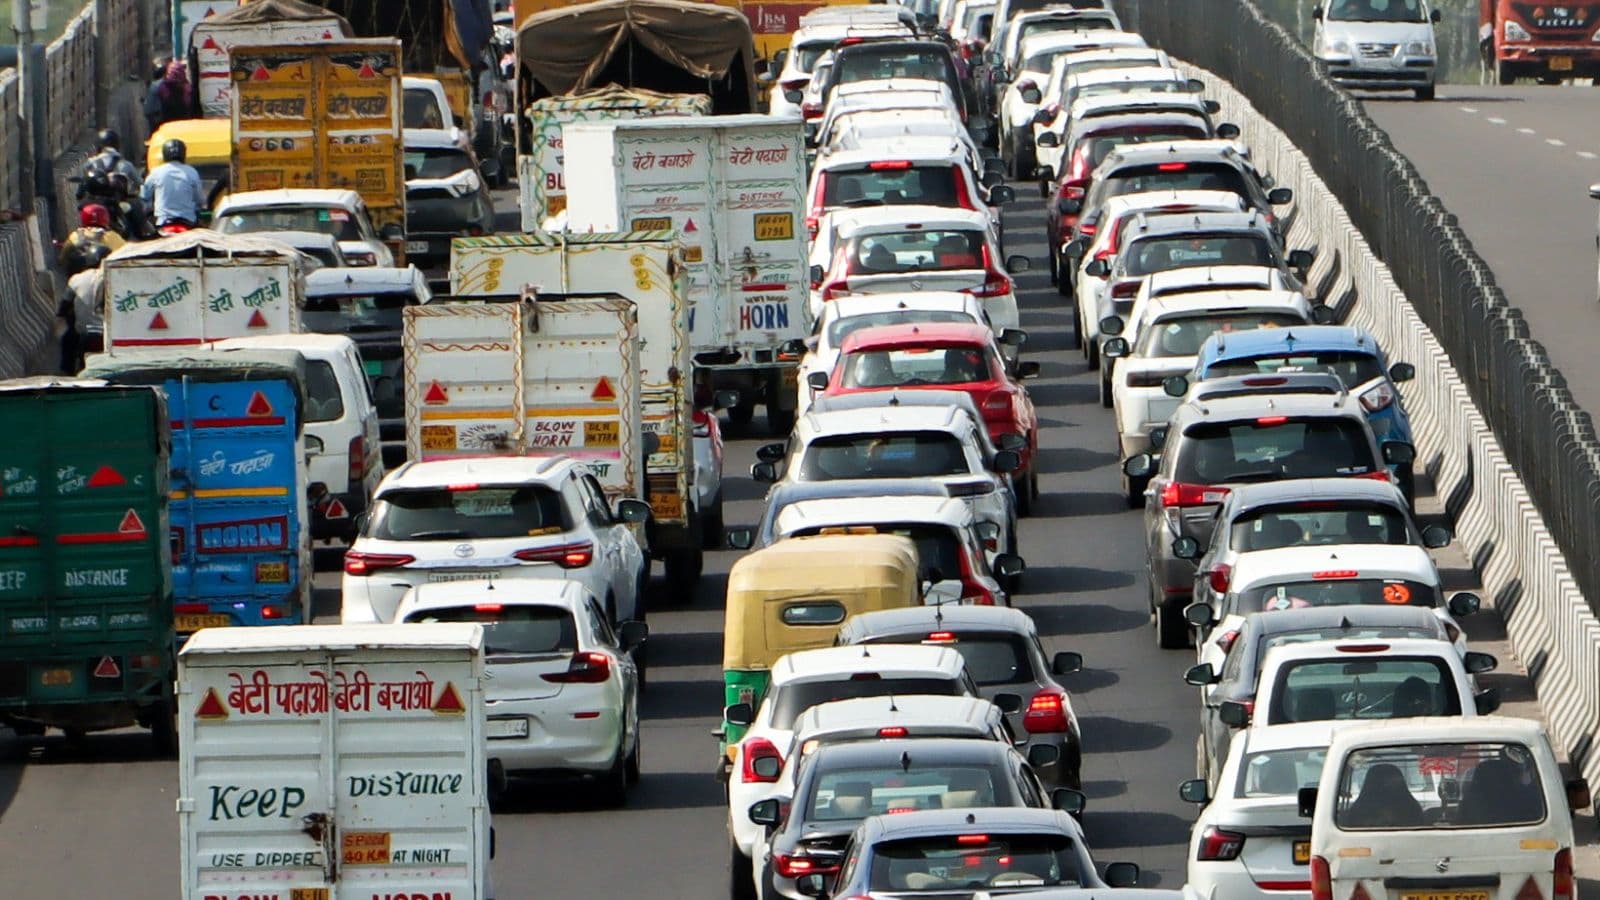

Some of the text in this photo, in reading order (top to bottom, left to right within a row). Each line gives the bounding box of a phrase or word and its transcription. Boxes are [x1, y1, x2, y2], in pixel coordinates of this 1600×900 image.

[739, 303, 789, 331] HORN
[535, 421, 576, 431] BLOW
[531, 434, 572, 448] HORN
[201, 522, 282, 549] HORN
[0, 568, 129, 590] EEP DISTANCE
[228, 670, 270, 714] बेटी
[335, 670, 375, 712] बेटी
[378, 671, 434, 711] बचाओ
[211, 851, 315, 867] USE DIPPER
[392, 848, 451, 863] AT NIGHT
